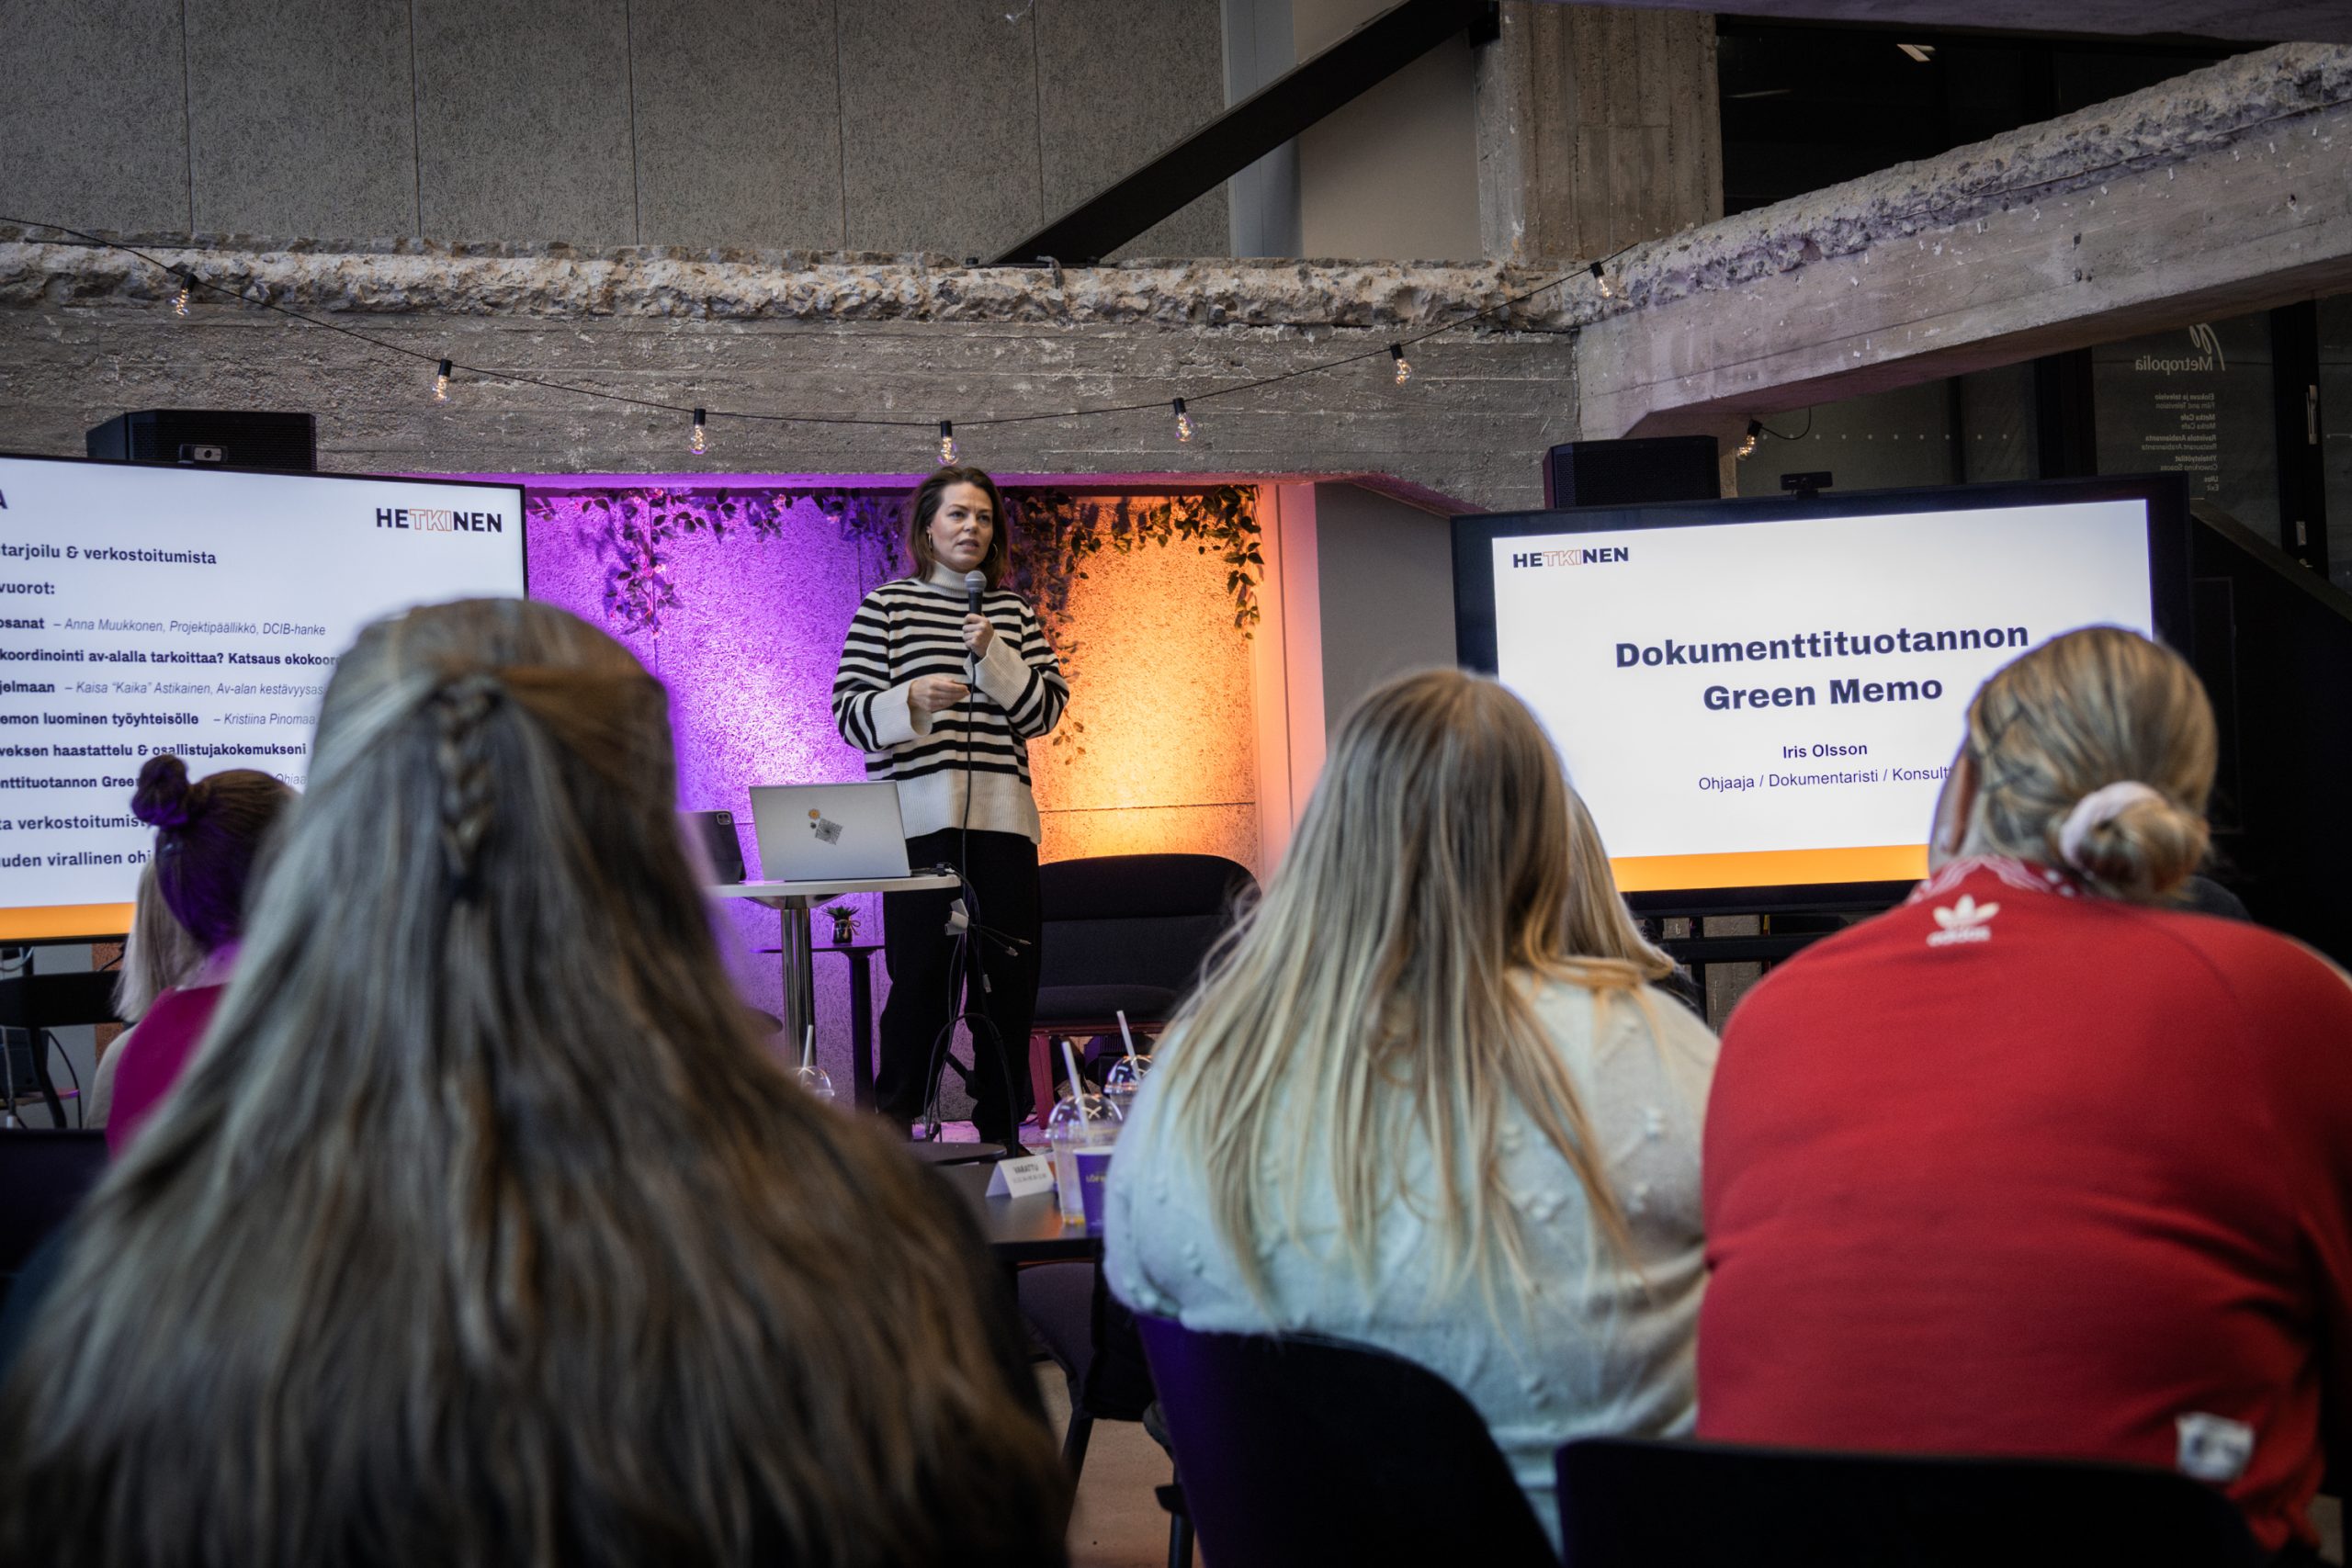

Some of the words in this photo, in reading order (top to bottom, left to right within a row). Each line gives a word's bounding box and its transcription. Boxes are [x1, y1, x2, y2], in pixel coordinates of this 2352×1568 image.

[375, 507, 503, 533] HETKINEN
[0, 543, 61, 561] tarjoilu
[66, 545, 80, 559] &
[83, 547, 217, 565] verkostoitumista
[1512, 547, 1630, 569] HETKINEN
[64, 617, 96, 632] Anna
[98, 618, 165, 634] Muukkonen,
[170, 620, 259, 637] Projektipäällikkö,
[263, 622, 326, 636] DCIB-hanke
[1615, 626, 2030, 669] Dokumenttituotannon
[0, 648, 85, 662] koordinointi
[88, 649, 147, 663] av-alalla
[151, 650, 224, 664] tarkoittaa?
[228, 652, 281, 665] Katsaus
[76, 681, 108, 694] Kaisa
[154, 682, 213, 696] Astikainen,
[217, 682, 257, 695] Av-alan
[1703, 685, 1816, 711] Green
[1829, 678, 1943, 705] Memo
[43, 712, 108, 725] luominen
[112, 712, 199, 728] työyhteisölle
[223, 713, 266, 726] Kristiina
[53, 743, 133, 757] haastattelu
[138, 744, 149, 757] &
[152, 742, 307, 758] osallistujakokemukseni
[1782, 745, 1807, 759] Iris
[1812, 742, 1868, 758] Olsson
[0, 775, 97, 789] nttituotannon
[1698, 775, 1755, 793] Ohjaaja
[1769, 769, 1879, 788] Dokumentaristi
[17, 813, 145, 830] verkostoitumis
[0, 853, 42, 868] uden
[47, 851, 123, 867] virallinen
